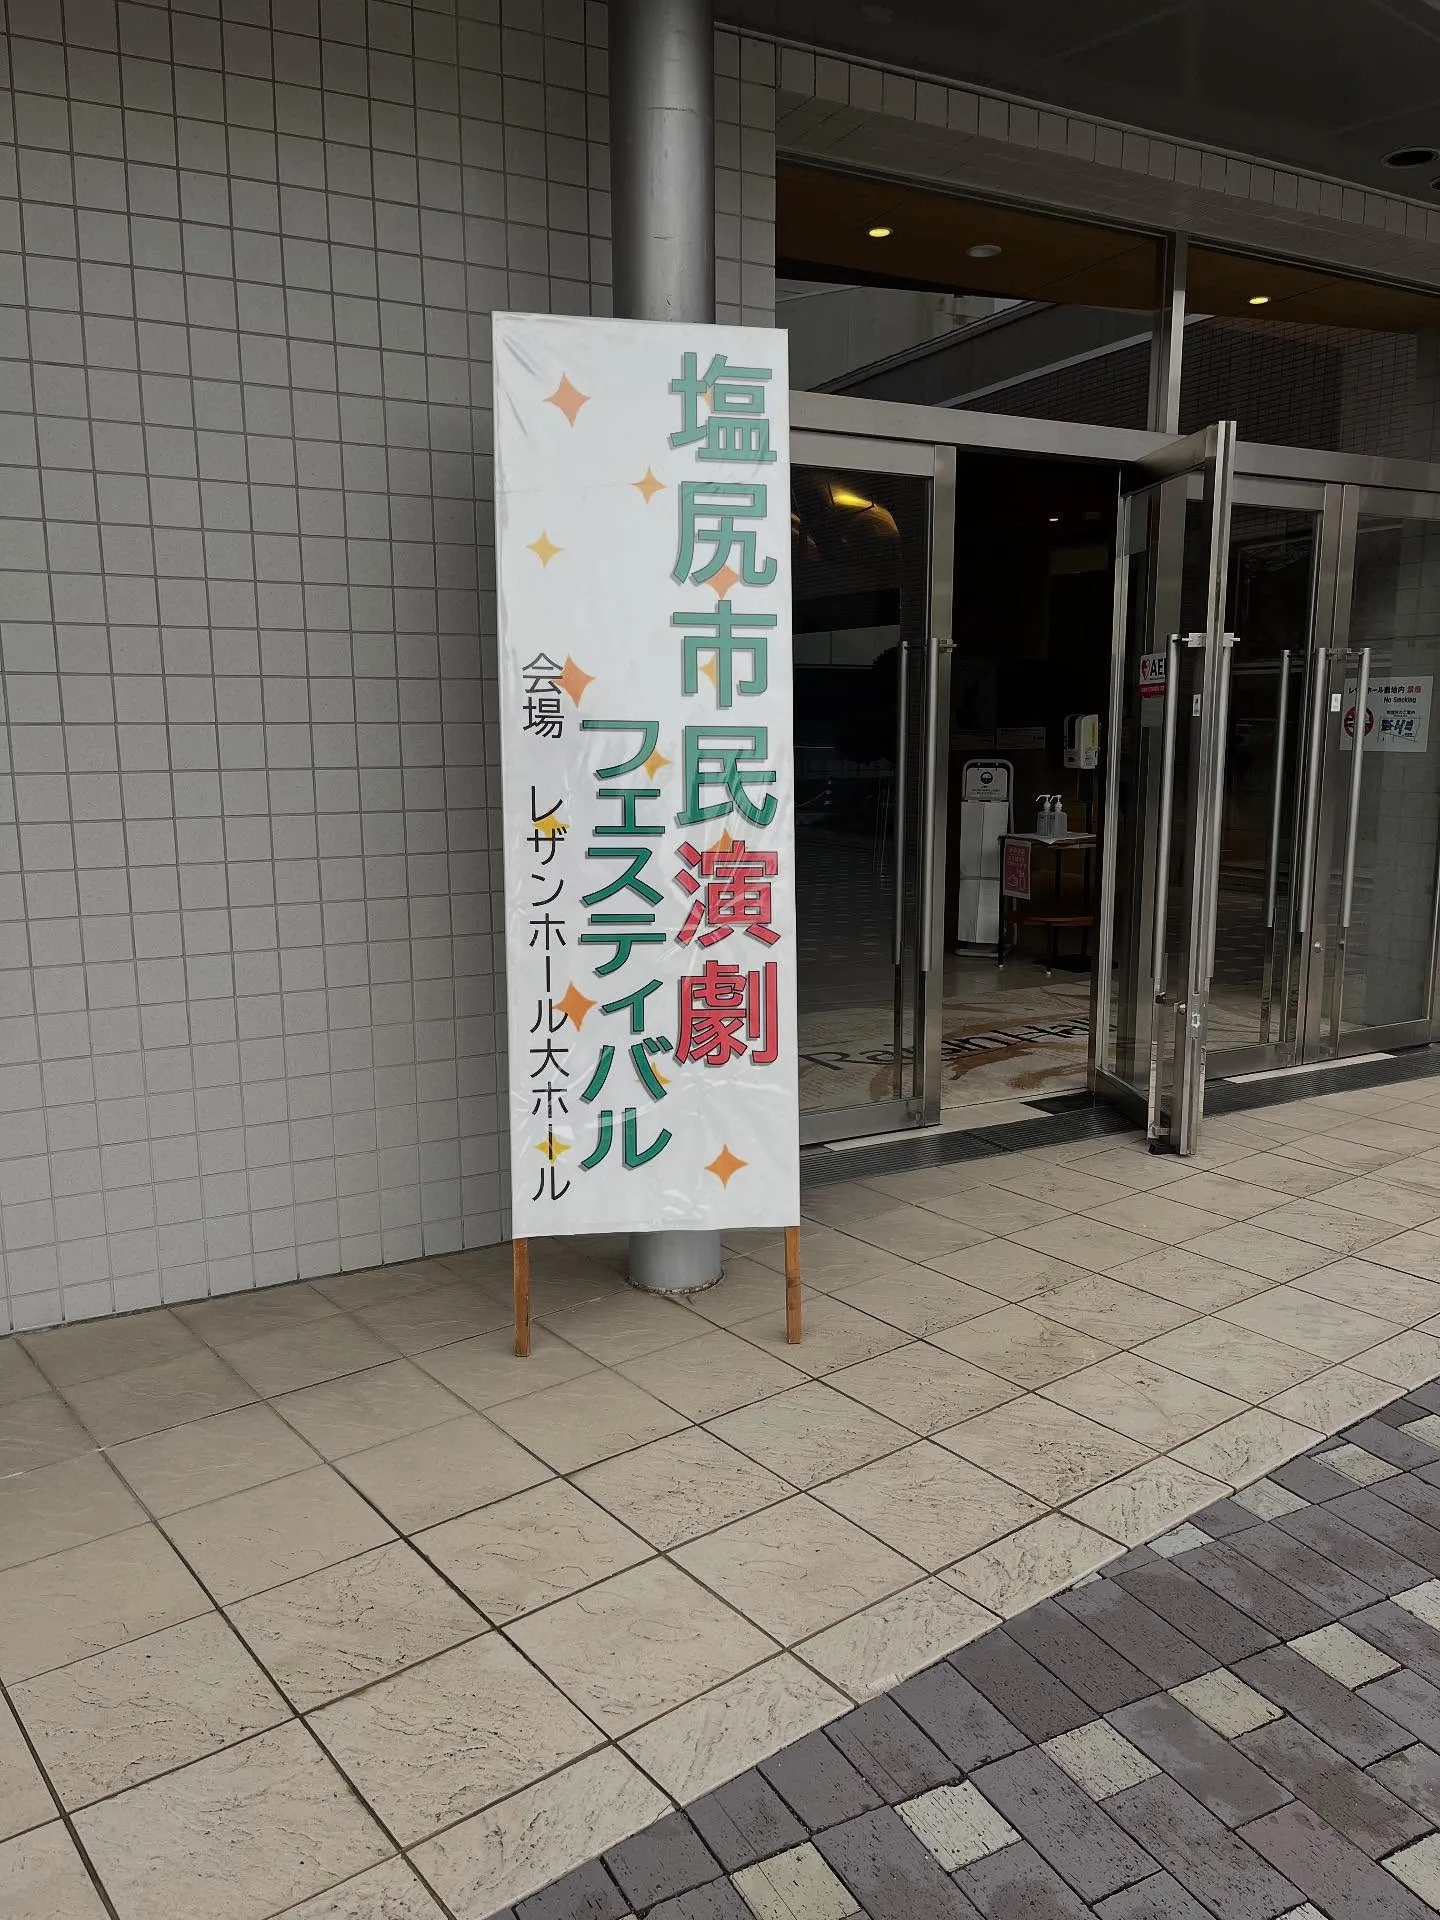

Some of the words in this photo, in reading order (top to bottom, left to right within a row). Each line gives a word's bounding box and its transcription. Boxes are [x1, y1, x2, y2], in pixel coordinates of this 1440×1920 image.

[522, 652, 565, 740] 会場
[669, 352, 780, 1066] 塩尻市民演劇
[1150, 658, 1166, 676] AE
[526, 785, 571, 1201] レザンホール大ホール
[578, 720, 674, 1172] フェスティバル
